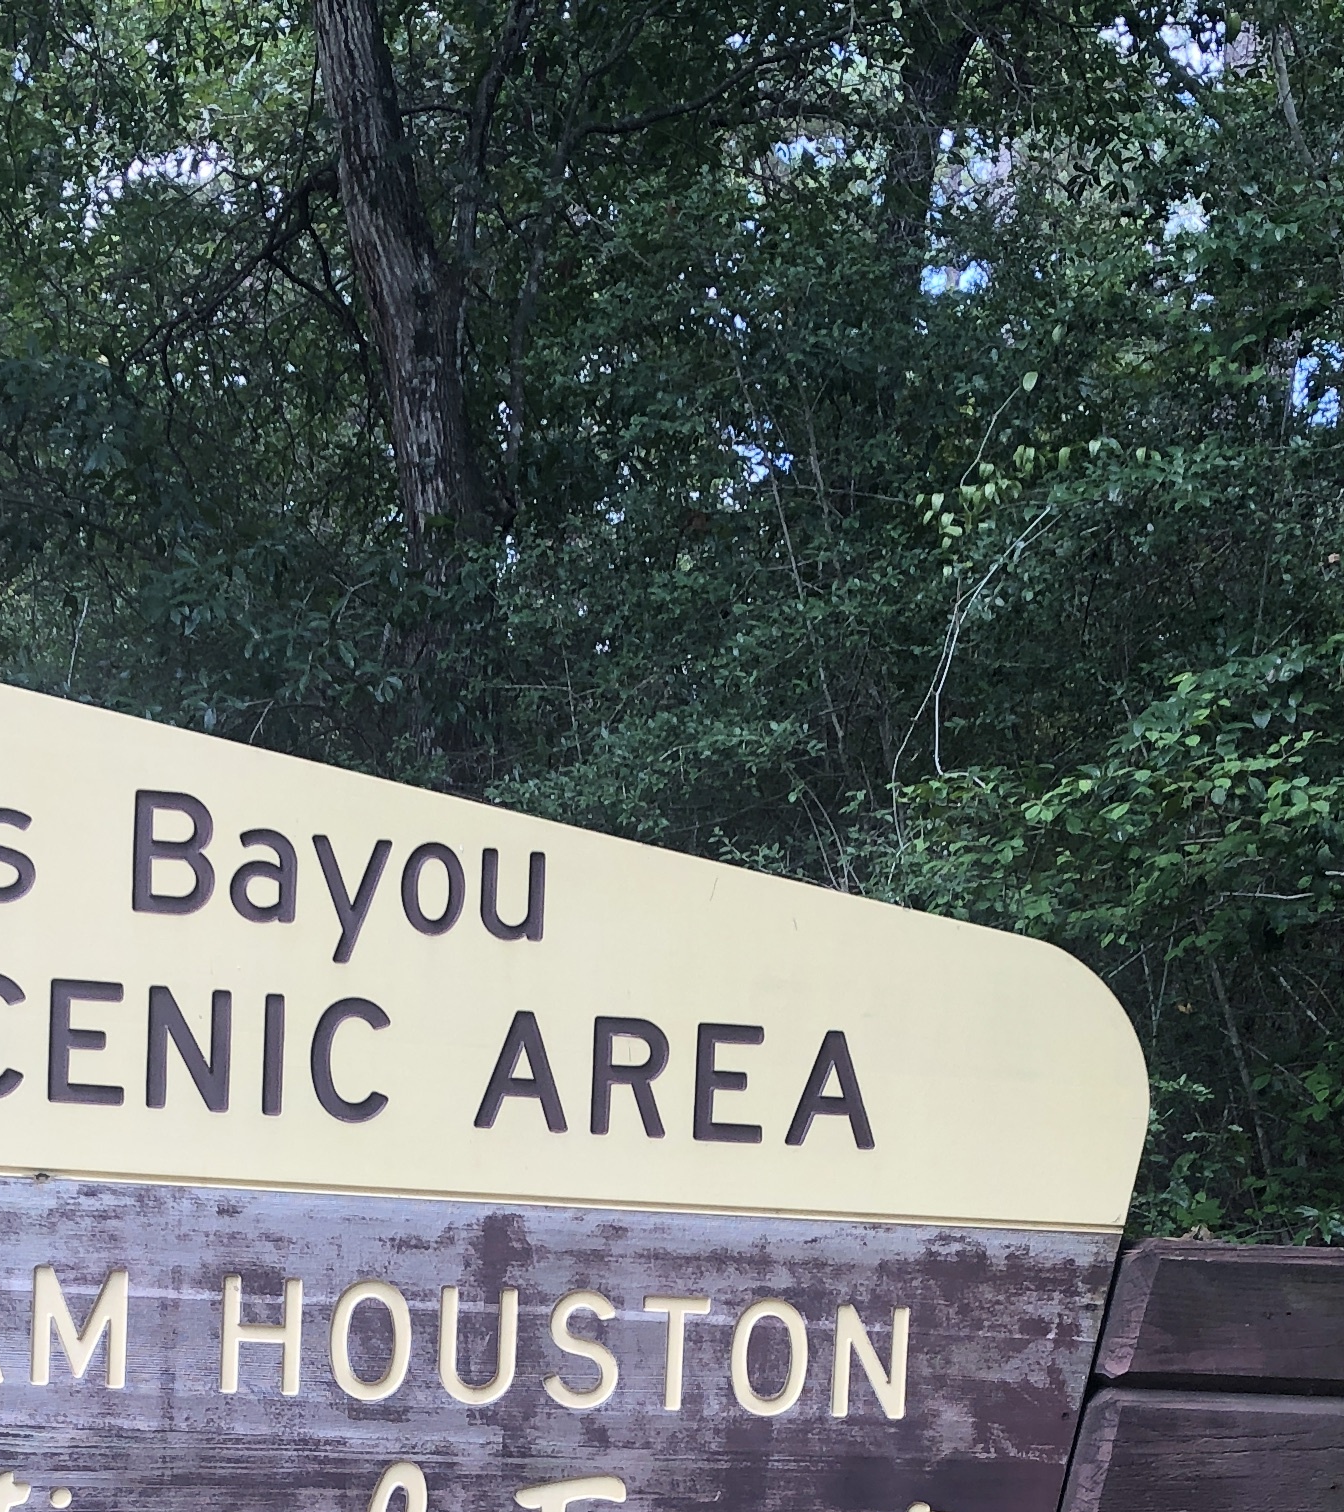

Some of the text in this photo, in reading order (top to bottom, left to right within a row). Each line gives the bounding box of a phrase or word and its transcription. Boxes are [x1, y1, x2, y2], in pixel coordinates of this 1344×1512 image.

[131, 788, 546, 963] Bayou
[473, 1009, 875, 1151] AREA
[219, 1273, 910, 1420] HOUSTON
